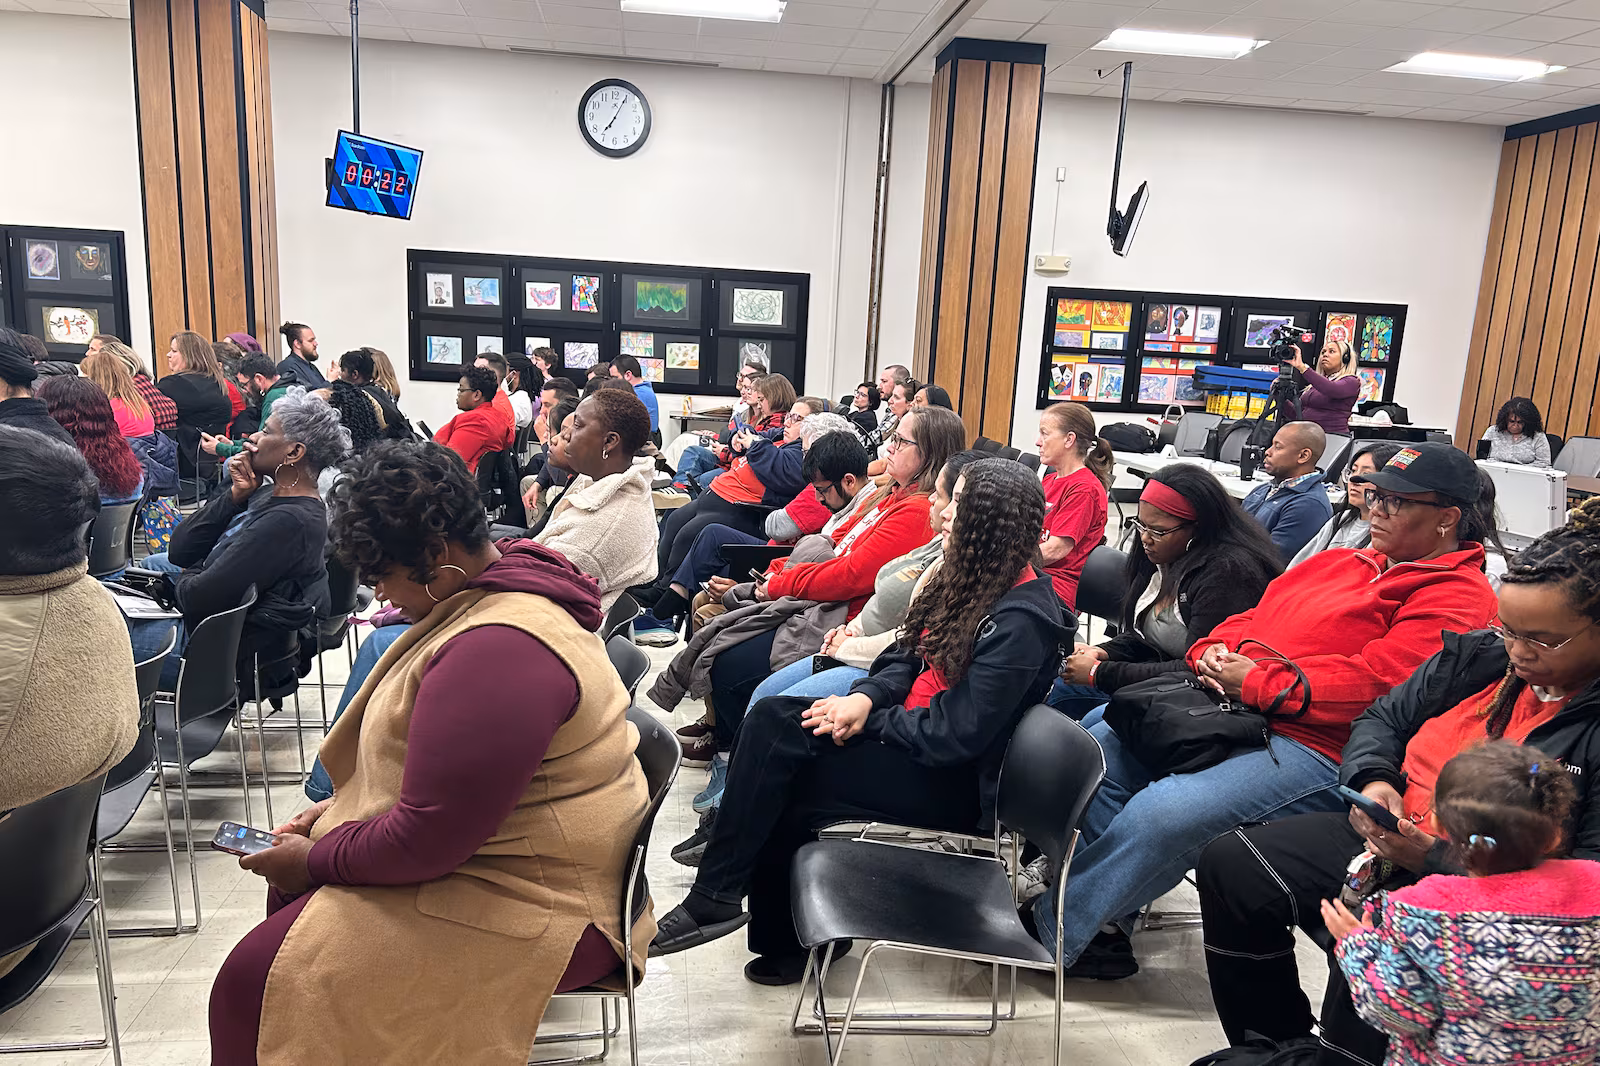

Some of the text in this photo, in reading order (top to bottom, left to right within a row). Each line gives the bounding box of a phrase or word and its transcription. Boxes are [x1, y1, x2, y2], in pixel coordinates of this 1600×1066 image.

[601, 92, 608, 102] 11
[611, 90, 620, 100] 12
[592, 100, 600, 110] 10
[632, 103, 637, 113] 2
[589, 112, 594, 121] 9
[635, 115, 641, 124] 3
[592, 124, 598, 133] 8
[601, 133, 606, 142] 7
[612, 137, 618, 146] 6
[623, 135, 629, 144] 5
[346, 165, 406, 193] 00:22
